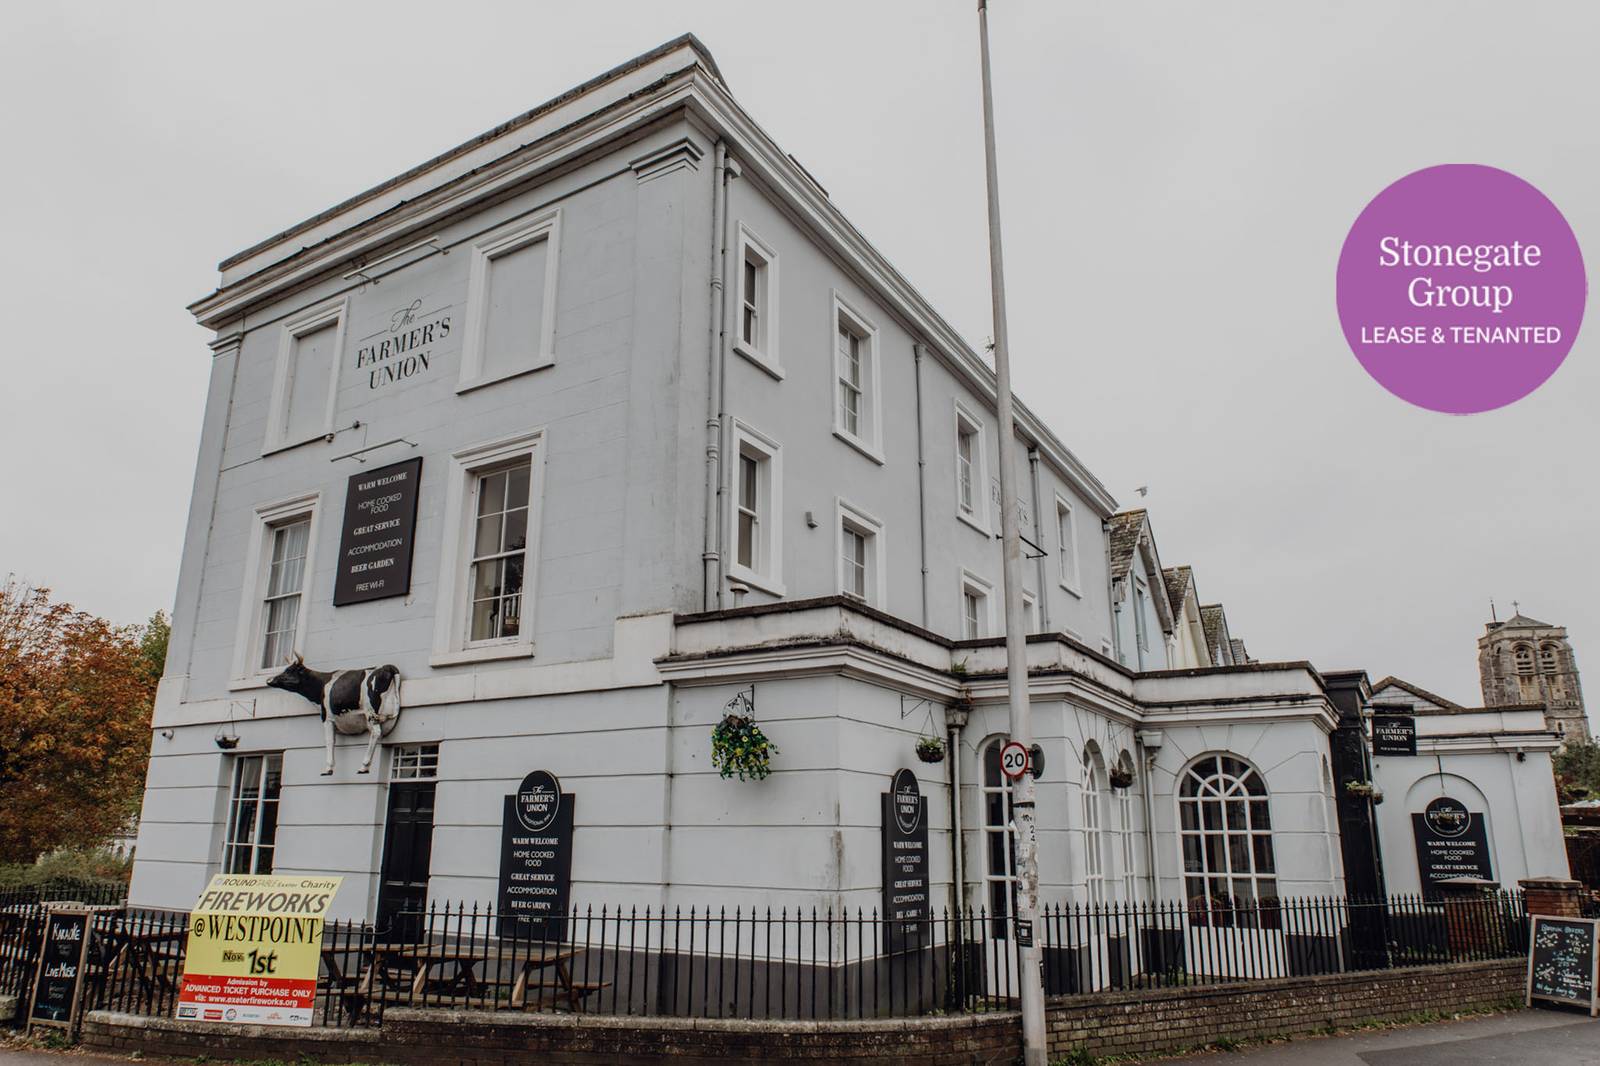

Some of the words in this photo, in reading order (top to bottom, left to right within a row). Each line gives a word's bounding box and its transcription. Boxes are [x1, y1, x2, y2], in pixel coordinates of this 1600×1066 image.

[390, 298, 423, 333] The
[355, 316, 451, 370] FARMER'S
[369, 350, 432, 390] UNION
[358, 480, 377, 491] WARM
[377, 472, 408, 487] WELCOME
[358, 500, 376, 511] HOME
[376, 492, 402, 506] COOKED
[370, 503, 389, 515] FOOD
[353, 524, 375, 536] GREAT
[374, 518, 401, 532] SERVICE
[347, 537, 403, 557] ACCOMMODATION
[351, 562, 368, 574] BEER
[367, 557, 395, 570] GARDEN
[355, 582, 370, 592] FREE
[1375, 728, 1414, 736] FARMER'S
[1382, 734, 1408, 742] UNION
[1004, 752, 1025, 769] 20
[520, 794, 555, 803] FARMER'S
[526, 803, 549, 813] UNION
[900, 804, 915, 814] UNION
[512, 837, 530, 845] WARM
[530, 837, 559, 845] WELCOME
[513, 850, 530, 859] HOME
[531, 850, 555, 859] COOKED
[525, 859, 543, 867] FOOD
[510, 873, 531, 881] GREAT
[530, 873, 556, 882] SERVICE
[300, 879, 337, 890] Charity
[506, 886, 558, 896] ACCOMMODATION
[199, 891, 330, 914] FIREWORKS
[193, 917, 206, 938] @
[208, 914, 319, 945] WESTPOINT
[247, 947, 278, 975] 1st
[226, 978, 259, 987] Admission
[259, 979, 269, 988] by
[184, 984, 221, 994] ADVANCED
[223, 986, 249, 995] TICKET
[250, 988, 290, 997] PURCHASE
[292, 990, 312, 998] ONLY
[208, 995, 299, 1008] www.exeterfireworks.org
